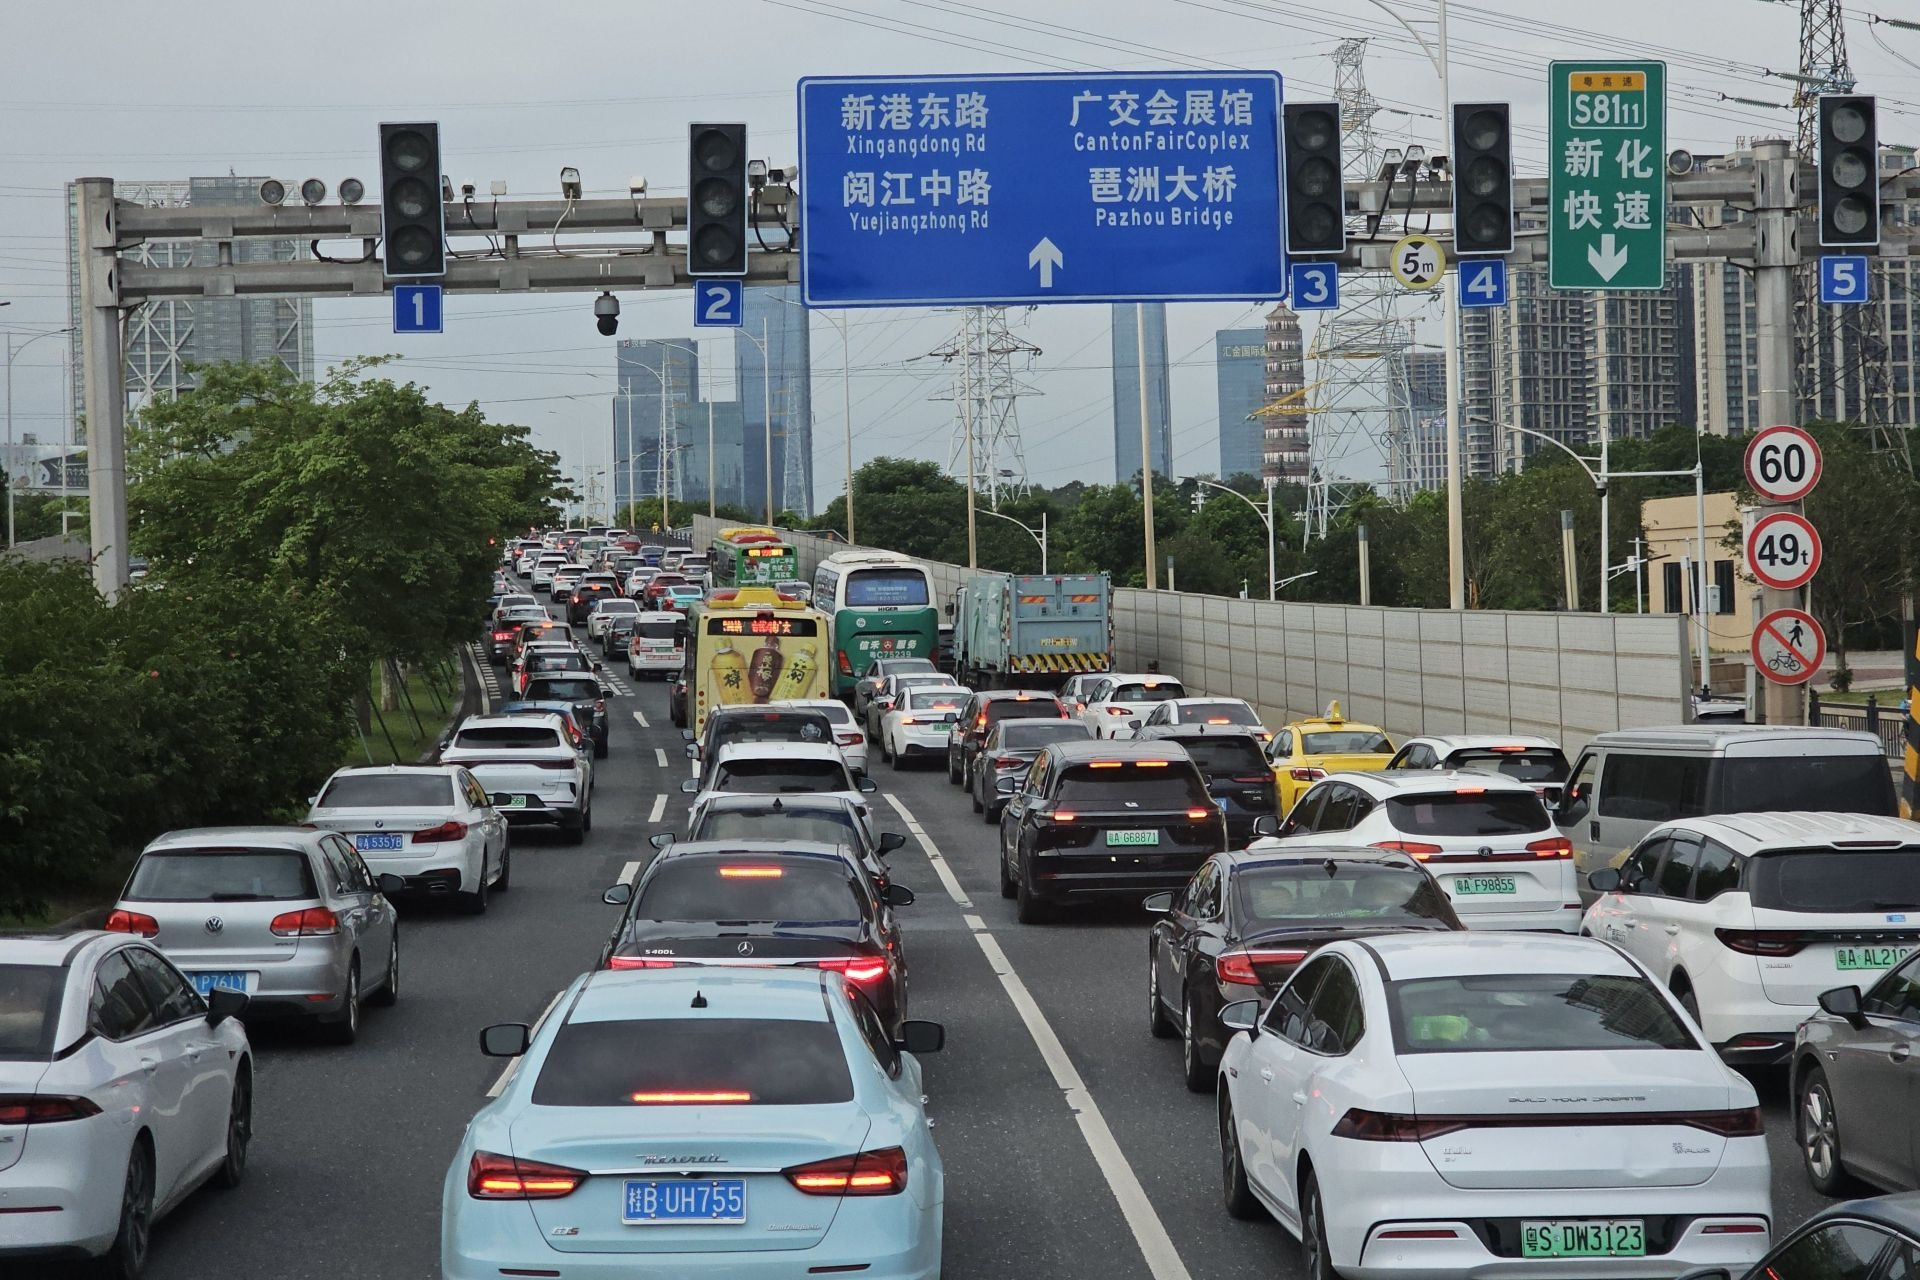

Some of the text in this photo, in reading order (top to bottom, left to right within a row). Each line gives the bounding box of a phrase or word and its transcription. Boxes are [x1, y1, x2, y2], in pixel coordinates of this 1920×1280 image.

[1583, 77, 1633, 87] 粤高速
[841, 92, 990, 130] 新港东路
[1069, 88, 1254, 128] 广交会展馆
[847, 133, 986, 158] Xingangdong Rd
[1074, 131, 1250, 153] CantonFairCoplex
[1564, 138, 1654, 179] 新化
[843, 168, 992, 207] 阅江中路
[1089, 165, 1237, 203] 琶洲大桥
[850, 210, 989, 235] Yuejiangzhong Rd
[1096, 207, 1233, 231] Pazhou Bridge
[1563, 190, 1652, 230] 快速
[1402, 252, 1434, 274] 5m
[1303, 270, 1328, 303] 3
[1467, 266, 1498, 299] 4
[1833, 264, 1856, 296] 5
[412, 292, 424, 326] 1
[705, 287, 732, 320] 2
[1759, 444, 1806, 484] 60
[1758, 534, 1808, 567] 49t
[1592, 1095, 1646, 1103] DREAMS
